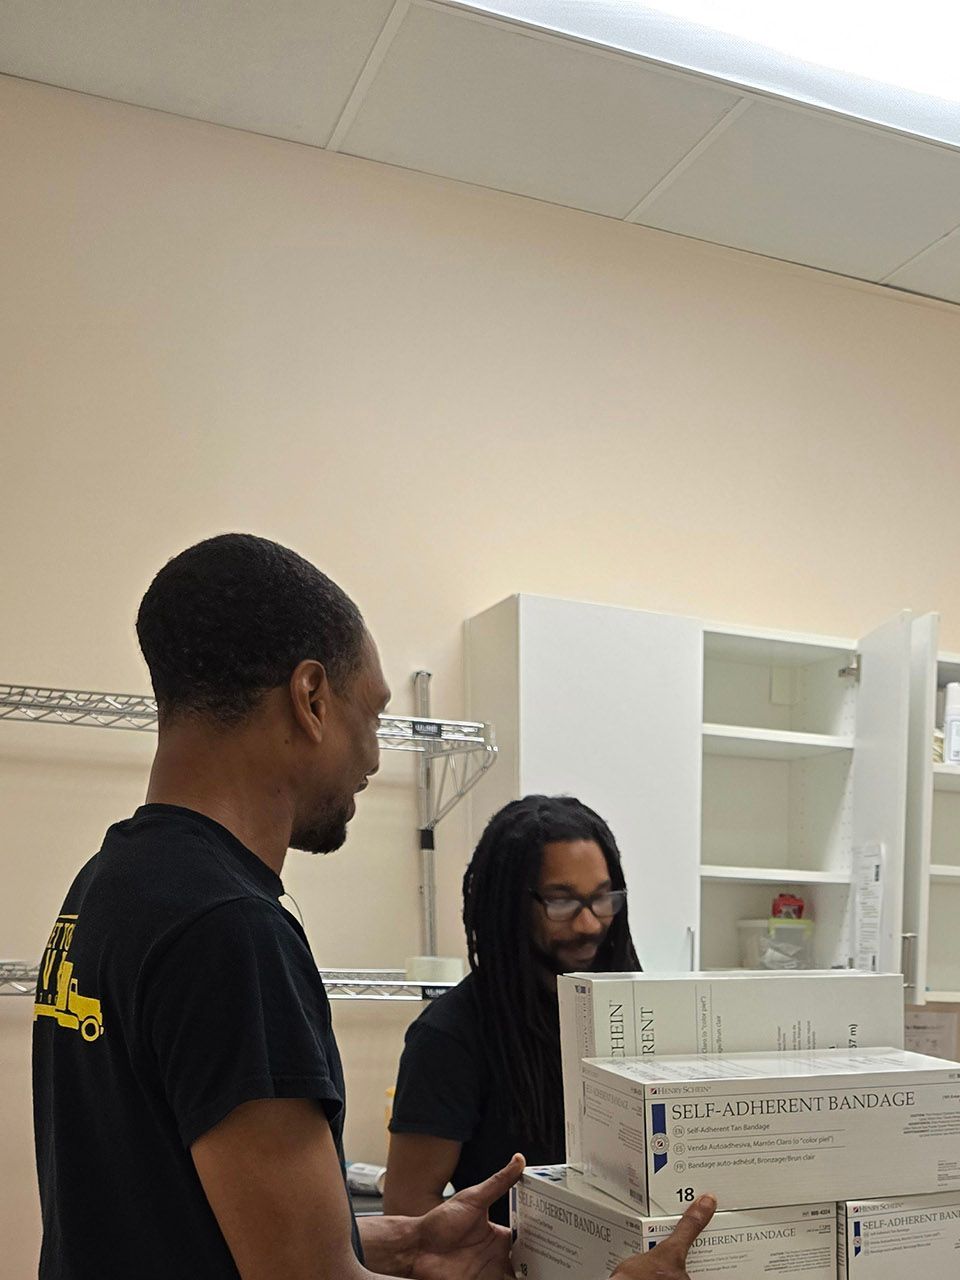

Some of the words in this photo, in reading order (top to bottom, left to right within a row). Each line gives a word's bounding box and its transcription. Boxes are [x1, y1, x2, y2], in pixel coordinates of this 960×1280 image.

[658, 1087, 683, 1096] HENRY
[672, 1097, 824, 1120] SELF-ADHERENT
[828, 1091, 916, 1112] BANDAGE
[687, 1124, 730, 1135] Self-Adherent
[743, 1123, 770, 1132] Bandage
[708, 1140, 752, 1151] Autoadhesiva,
[688, 1160, 716, 1170] Bandage
[757, 1154, 801, 1165] Bronzage/Brun
[676, 1187, 695, 1202] 18
[859, 1204, 880, 1213] HENRY
[519, 1191, 574, 1227] SELF-ADHERENT
[573, 1214, 611, 1243] BANDAGE
[863, 1214, 939, 1231] SELF-ADHERENT
[655, 1225, 676, 1233] HENR
[747, 1228, 796, 1242] BANDAGE
